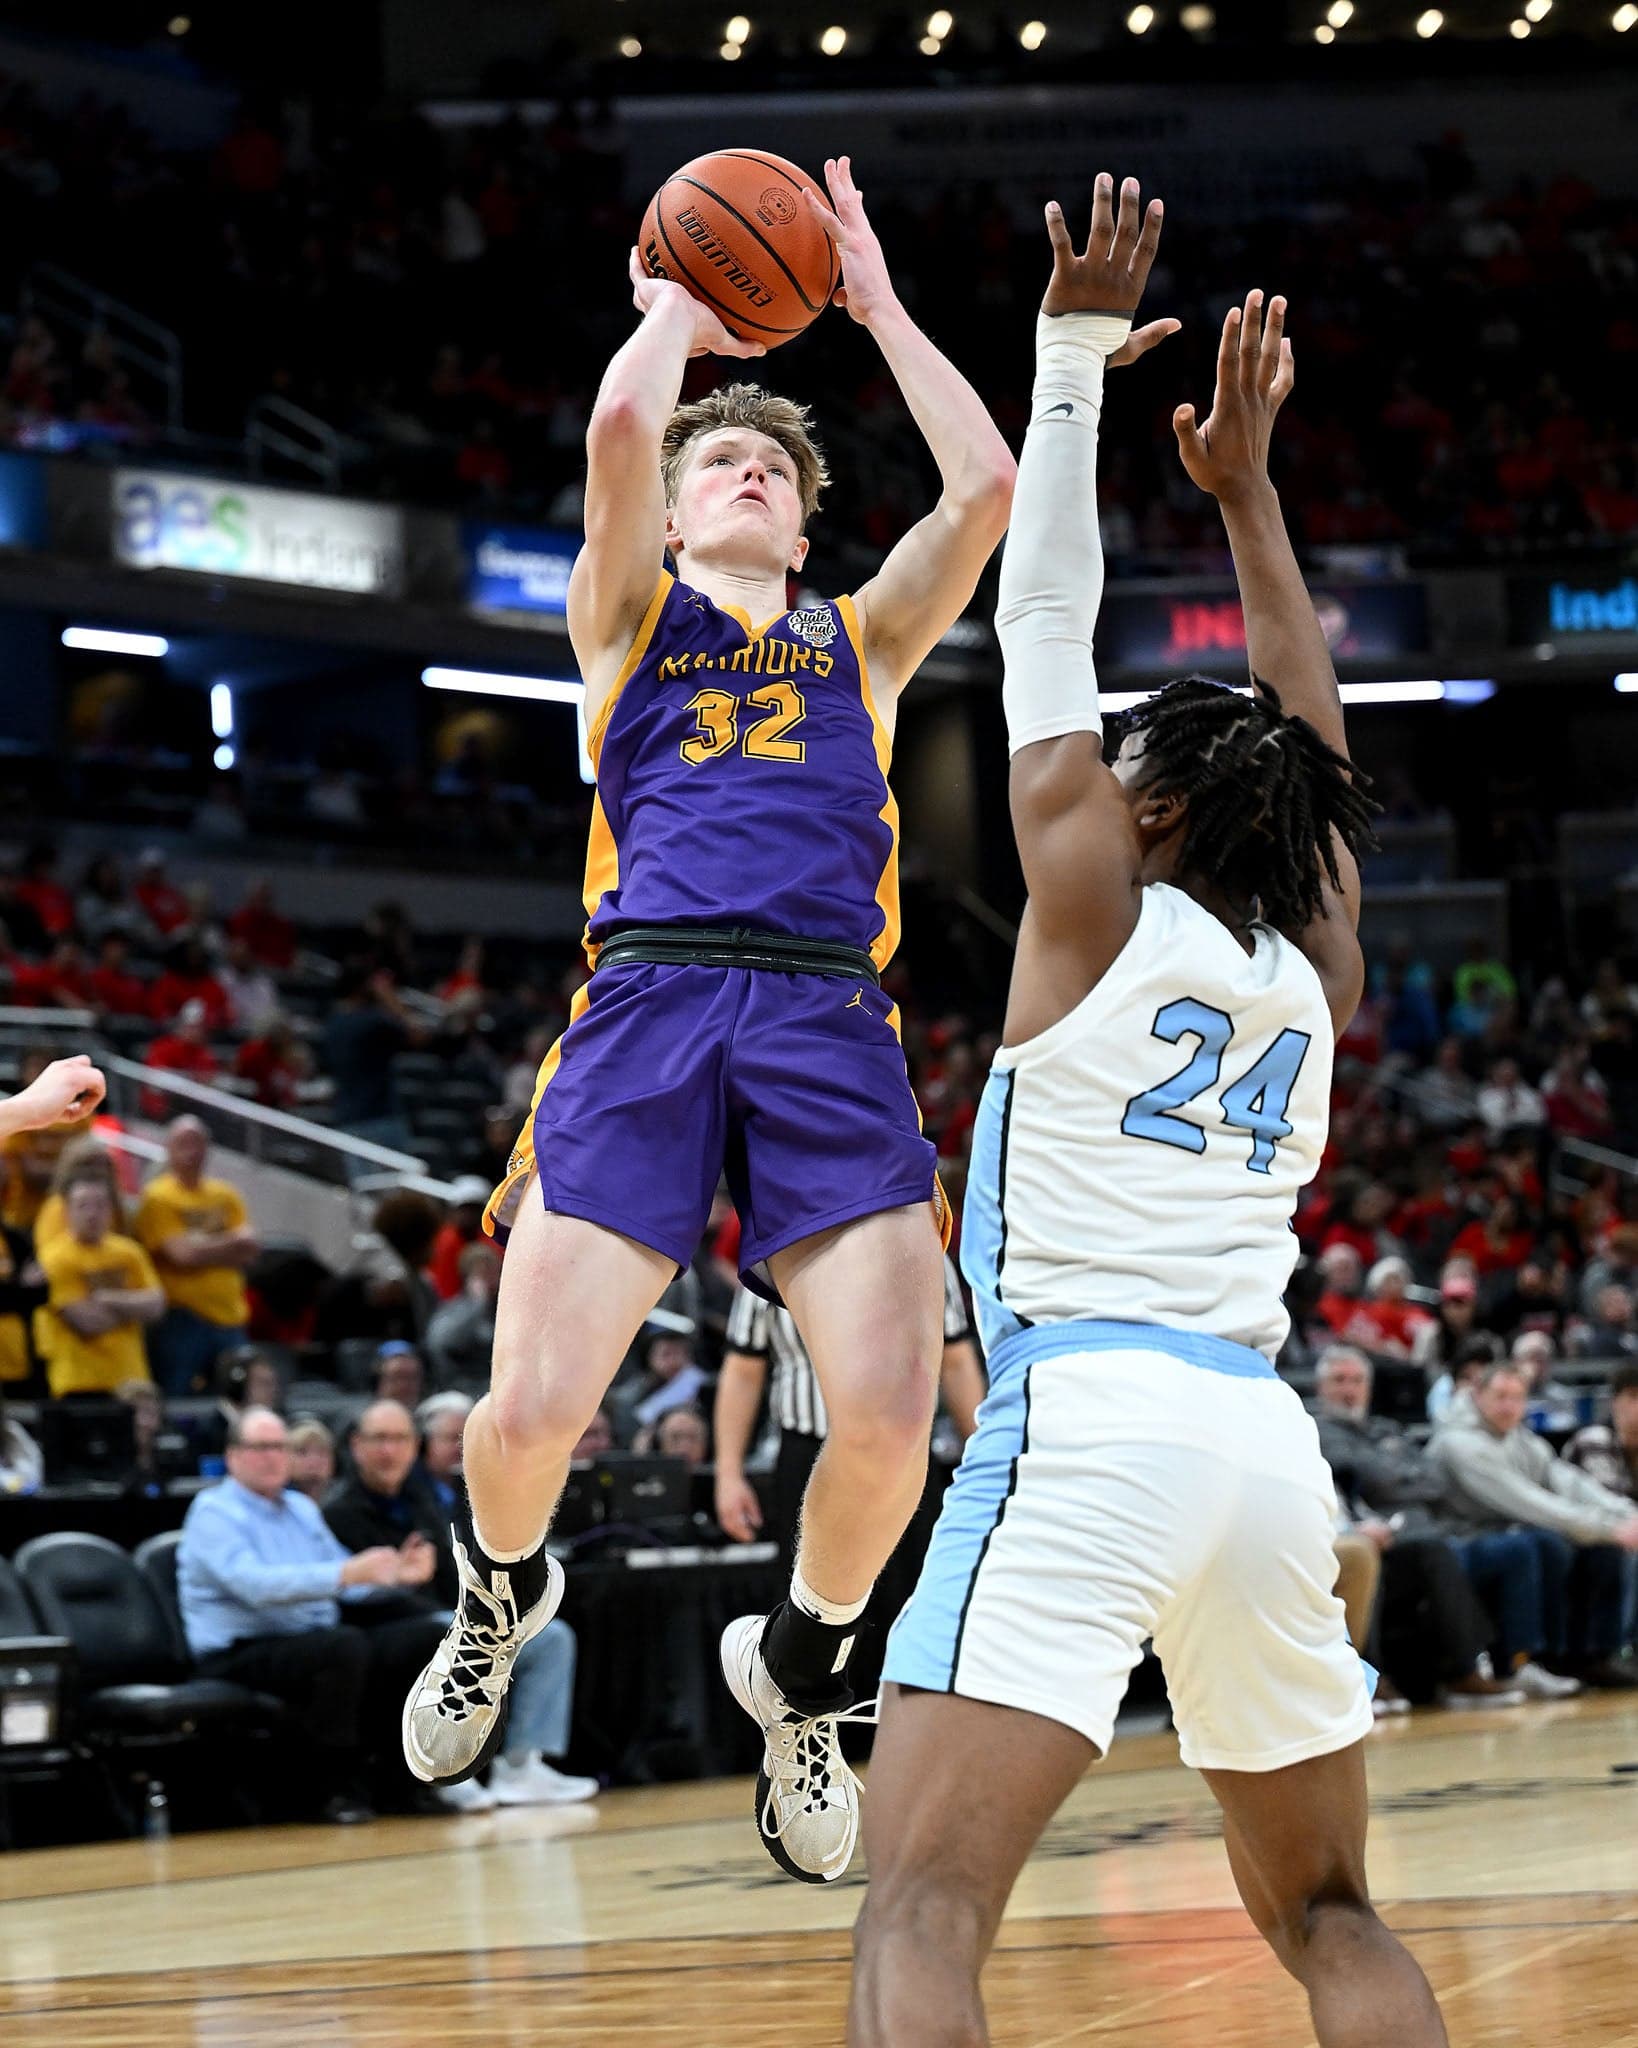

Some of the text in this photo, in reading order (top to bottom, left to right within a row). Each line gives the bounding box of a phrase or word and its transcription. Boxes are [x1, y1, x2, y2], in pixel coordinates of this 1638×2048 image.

[676, 209, 774, 308] EVOLUTION
[790, 608, 832, 623] State
[792, 621, 836, 637] Finals
[657, 637, 835, 682] WARIORS
[680, 679, 807, 767] 32
[1120, 995, 1312, 1176] 24
